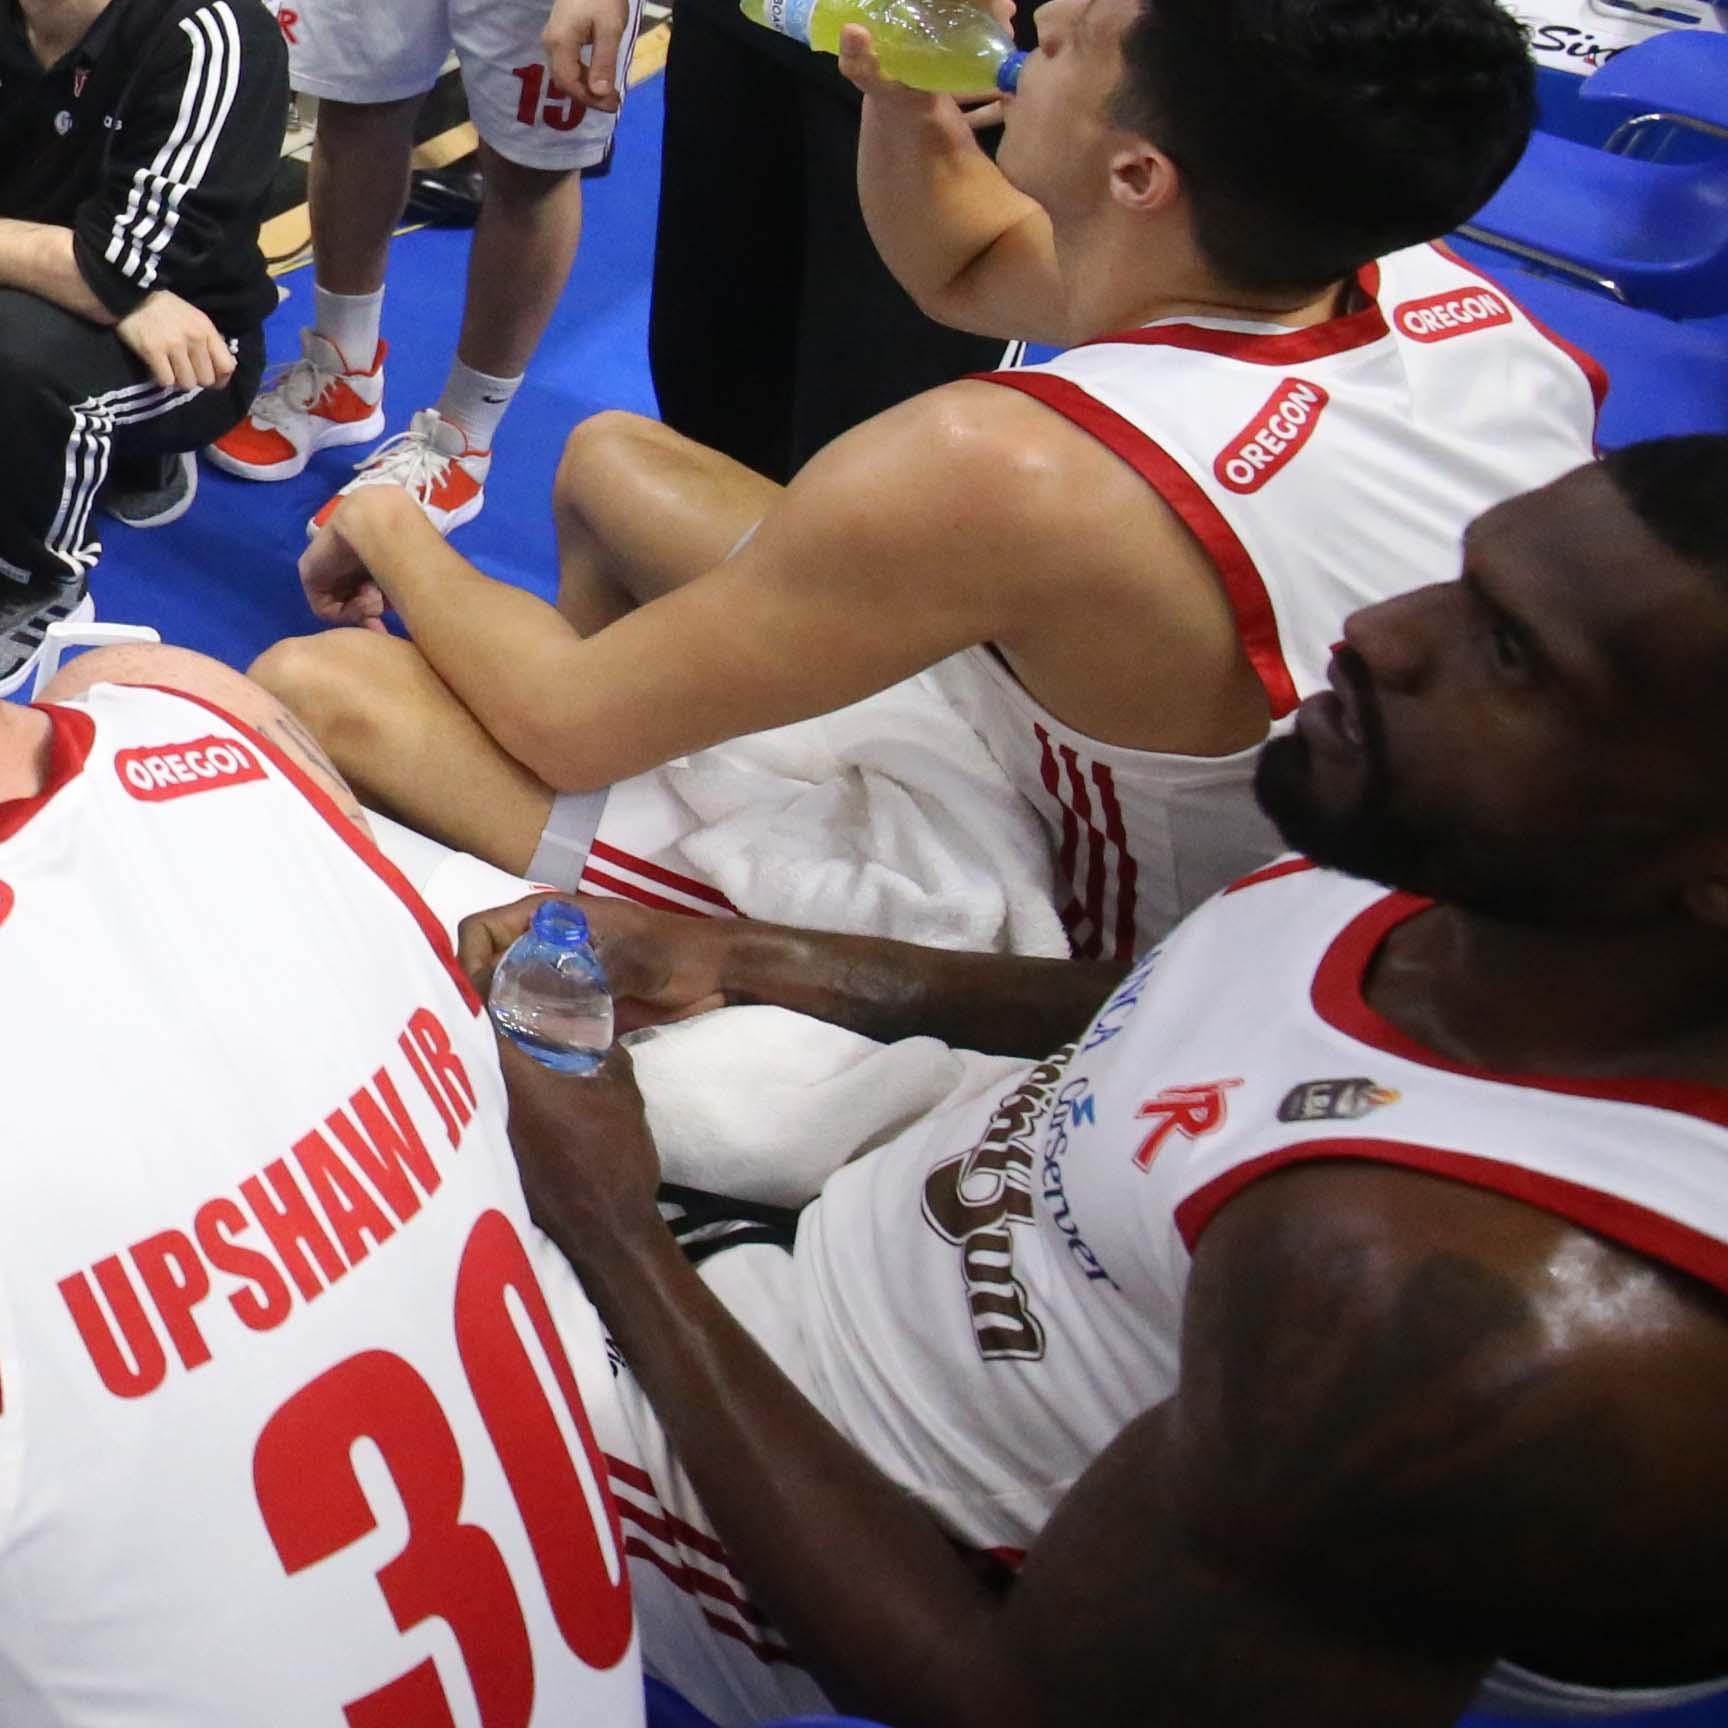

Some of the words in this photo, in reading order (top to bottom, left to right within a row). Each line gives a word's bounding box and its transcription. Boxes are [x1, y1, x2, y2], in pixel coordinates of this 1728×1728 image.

[513, 63, 586, 131] 15
[1401, 294, 1505, 338] OREGON
[1225, 381, 1323, 486] OREGON
[57, 1063, 444, 1400] UPSHAW
[398, 1004, 478, 1152] JR
[252, 1208, 634, 1728] 30
